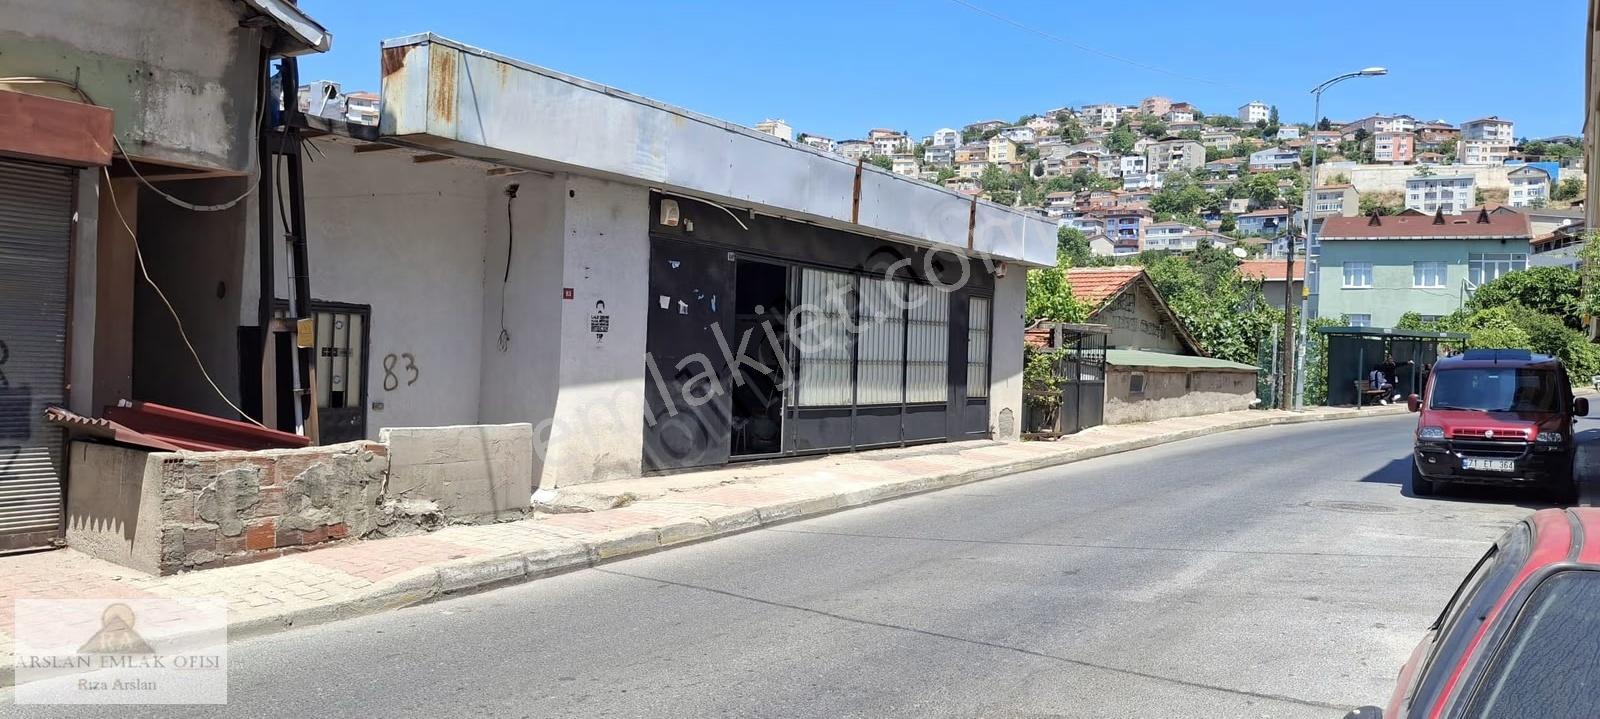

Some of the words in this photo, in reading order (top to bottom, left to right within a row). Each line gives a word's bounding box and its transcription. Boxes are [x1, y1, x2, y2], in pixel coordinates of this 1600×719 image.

[383, 353, 419, 391] 83
[1484, 460, 1492, 468] ET
[1499, 460, 1513, 469] 364
